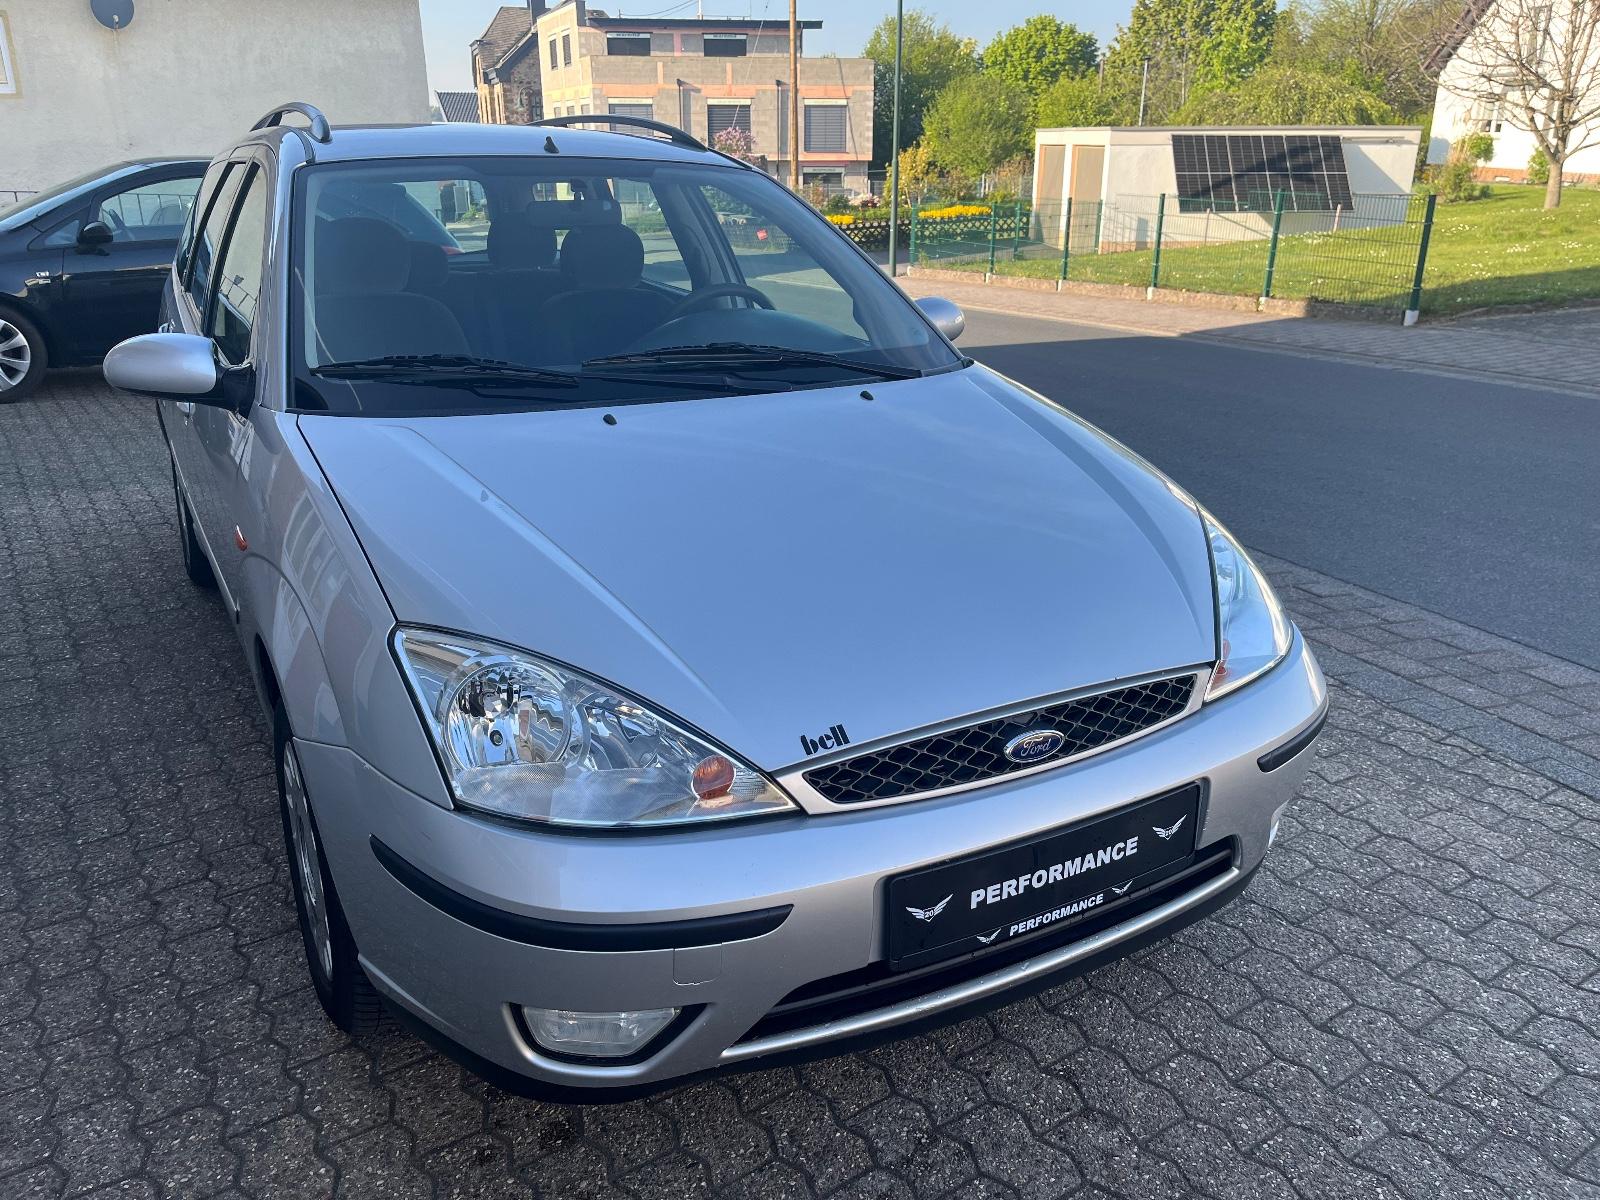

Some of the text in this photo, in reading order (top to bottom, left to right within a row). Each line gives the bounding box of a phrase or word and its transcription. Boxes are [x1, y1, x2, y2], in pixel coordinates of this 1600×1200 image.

[801, 724, 850, 755] bell
[1020, 736, 1052, 757] Ford
[971, 836, 1139, 909] PERFORMANCE
[1010, 894, 1104, 936] PERFORMANCE
